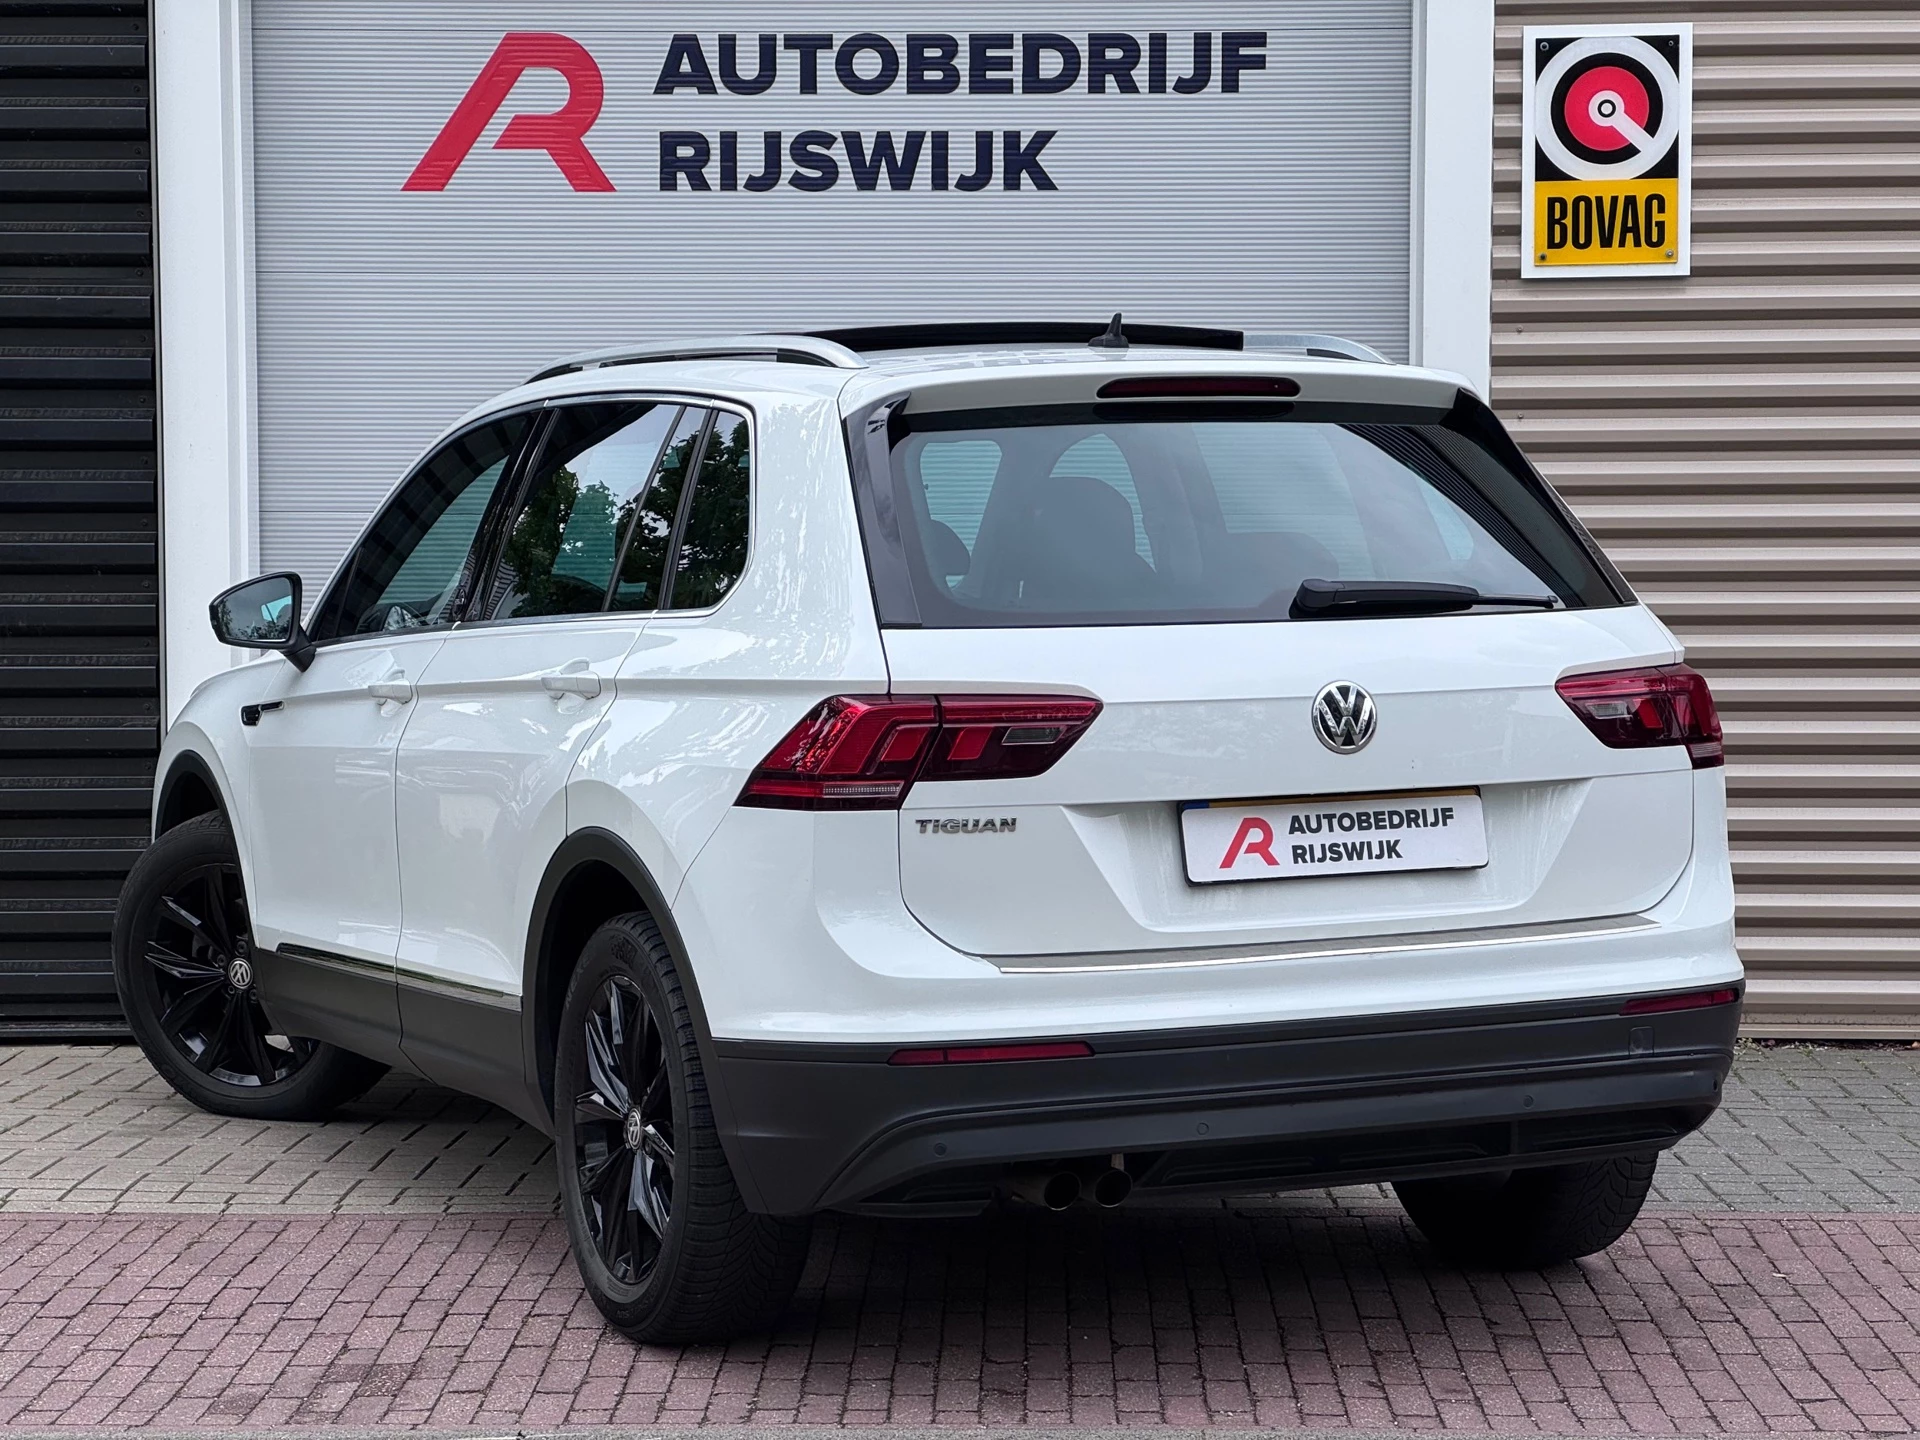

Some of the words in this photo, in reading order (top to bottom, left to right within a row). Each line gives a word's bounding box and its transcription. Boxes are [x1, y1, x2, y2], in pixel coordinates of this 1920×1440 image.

[653, 31, 1267, 95] AUTOBEDRIJF
[659, 129, 1059, 192] RIJSWIJK
[1546, 193, 1666, 250] BOVAG
[1314, 682, 1375, 752] VW
[915, 817, 1017, 834] TIGUAN
[1288, 807, 1455, 835] AUTOBEDRIJF
[1292, 839, 1403, 865] RIJSWIJK
